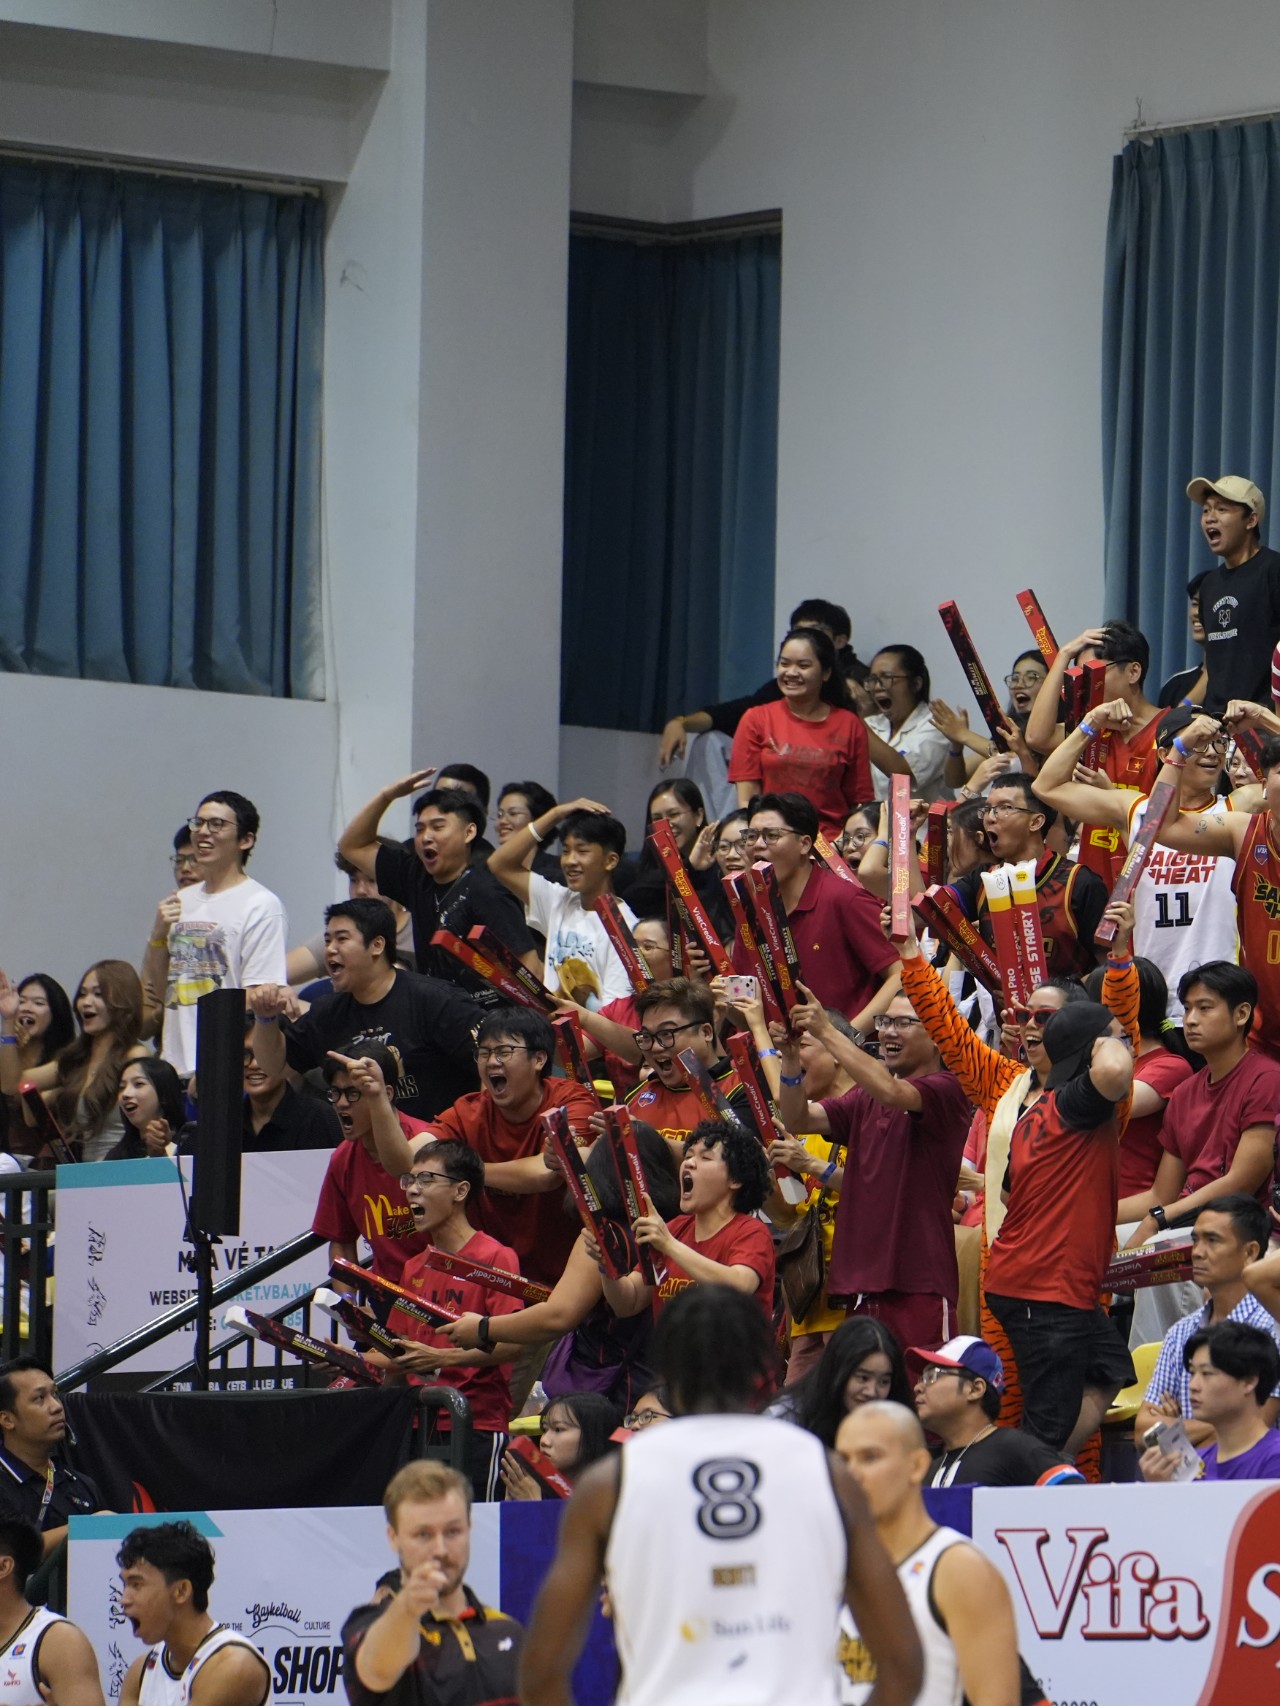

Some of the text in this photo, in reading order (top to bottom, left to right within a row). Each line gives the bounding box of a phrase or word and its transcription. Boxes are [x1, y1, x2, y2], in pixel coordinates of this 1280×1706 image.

[895, 811, 906, 855] VietCredit
[1154, 866, 1216, 886] HEAT
[691, 906, 719, 949] VietCredit
[761, 905, 780, 951] VietCredit
[1155, 891, 1194, 929] 11
[610, 932, 634, 971] VietCredit
[1021, 910, 1039, 962] STARRY
[978, 949, 1002, 978] VietCre
[754, 962, 776, 1007] VietCredit
[744, 1079, 767, 1126] VietCredit
[627, 1150, 647, 1198] VietCredit
[465, 1266, 512, 1287] VietCredit
[1100, 1278, 1137, 1288] VietCre
[1106, 1262, 1141, 1275] VietCre
[150, 1289, 198, 1306] WEBSI
[692, 1457, 762, 1540] 8
[996, 1527, 1210, 1641] Vifa
[232, 1622, 243, 1632] THE
[245, 1601, 302, 1629] Basketball
[304, 1621, 331, 1631] CULTURE
